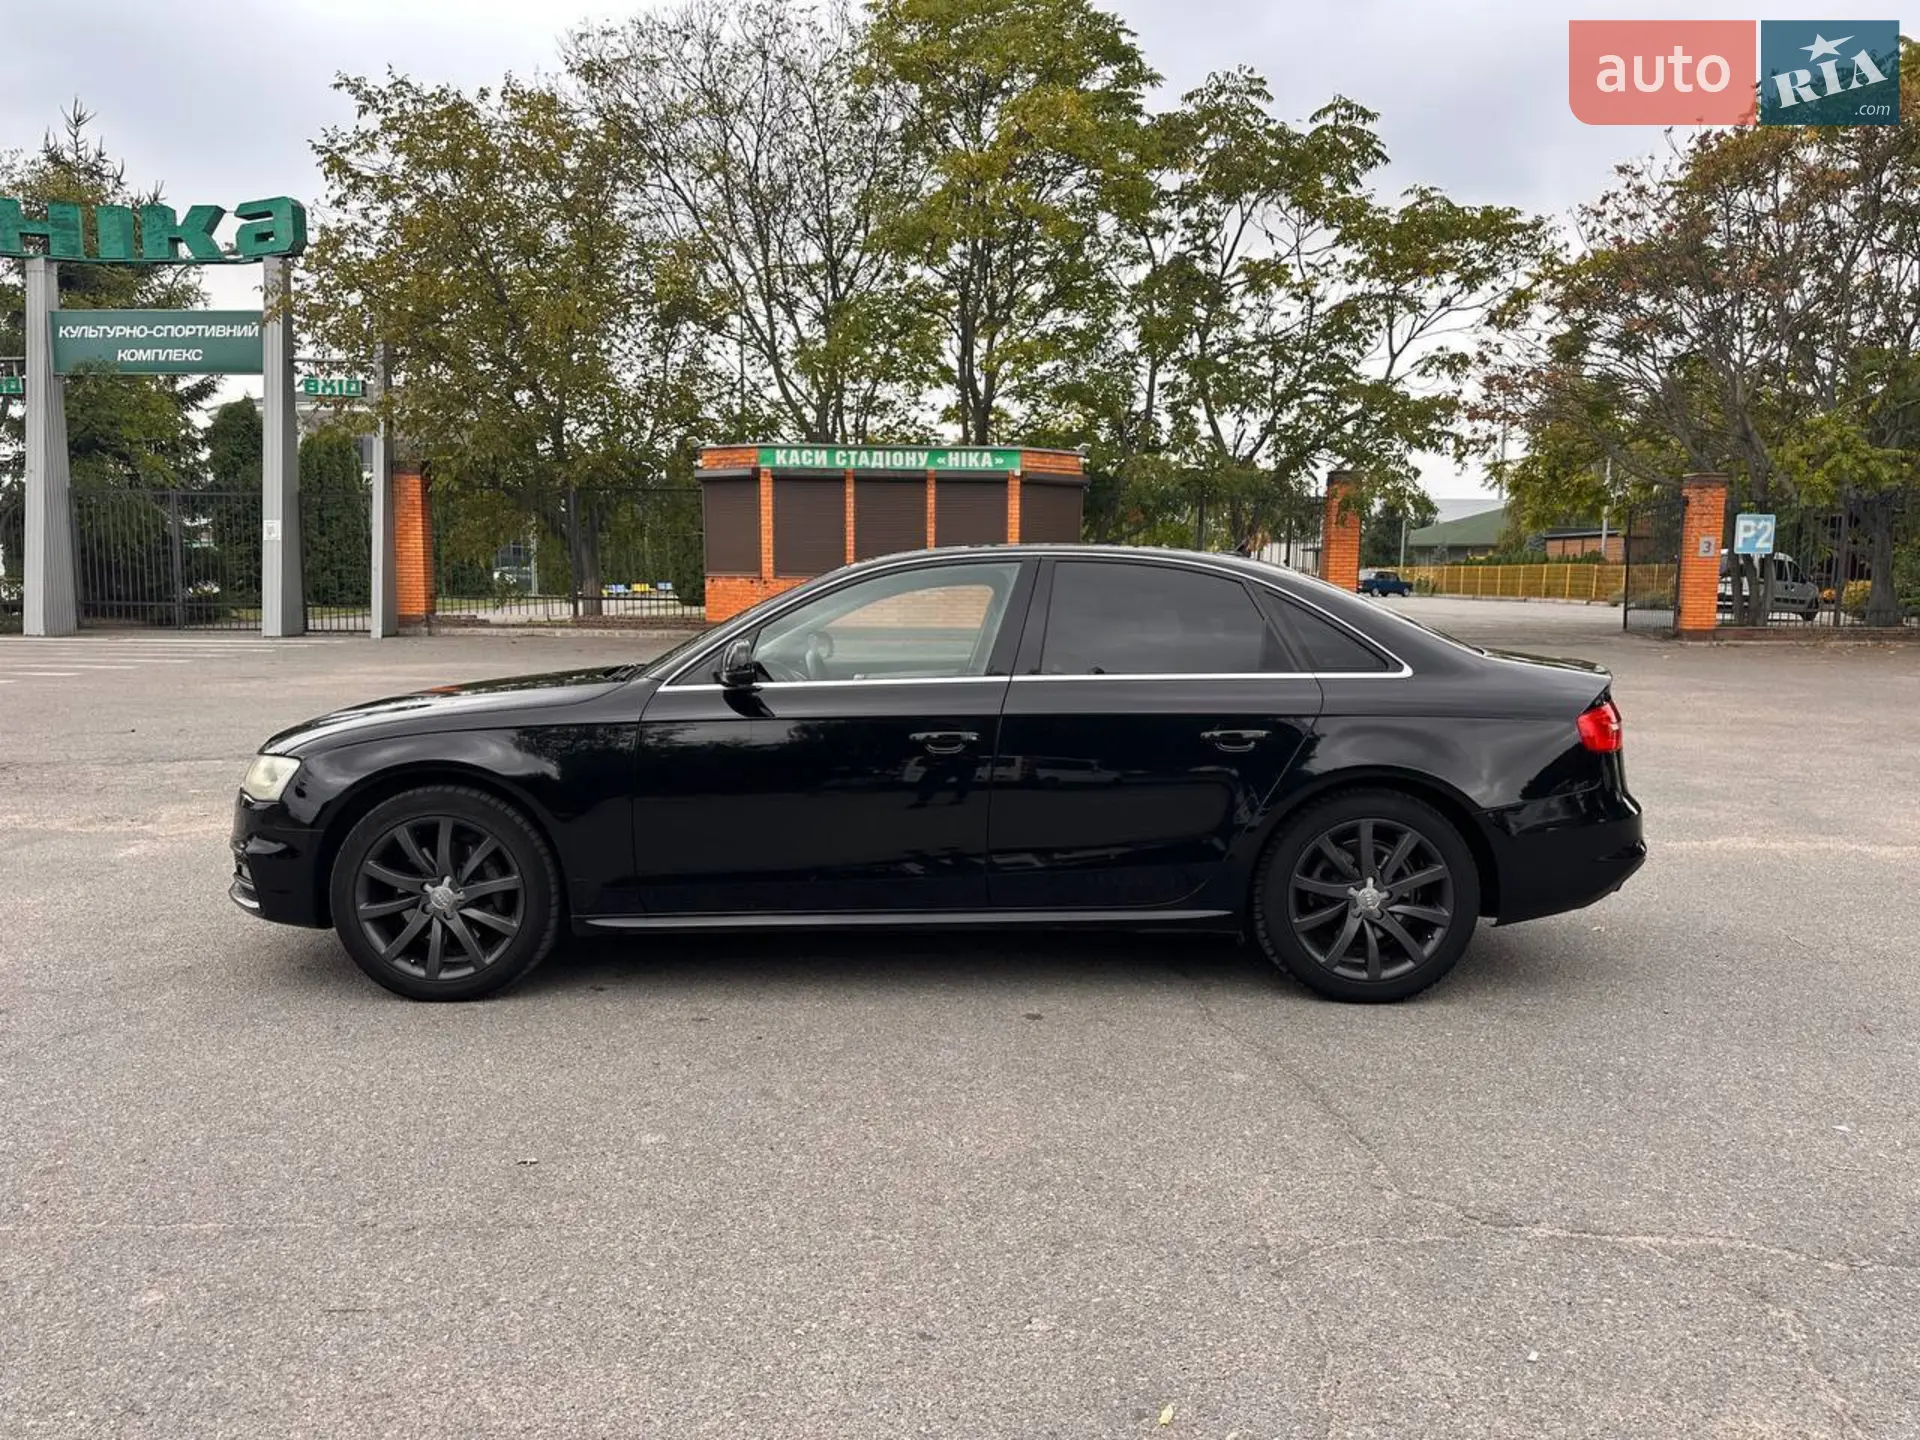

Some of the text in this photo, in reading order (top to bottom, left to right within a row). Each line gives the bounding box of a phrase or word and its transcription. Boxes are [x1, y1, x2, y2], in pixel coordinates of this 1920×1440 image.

[59, 322, 260, 338] КУЛЬТУРНО-СПОРТИВНИЙ
[117, 348, 203, 362] КОМПЛЕКС
[304, 379, 361, 394] ВХІД
[775, 449, 828, 466] КАСИ
[835, 451, 929, 468] СТАДІОНУ
[1738, 520, 1773, 548] P2
[1702, 541, 1712, 553] 3
